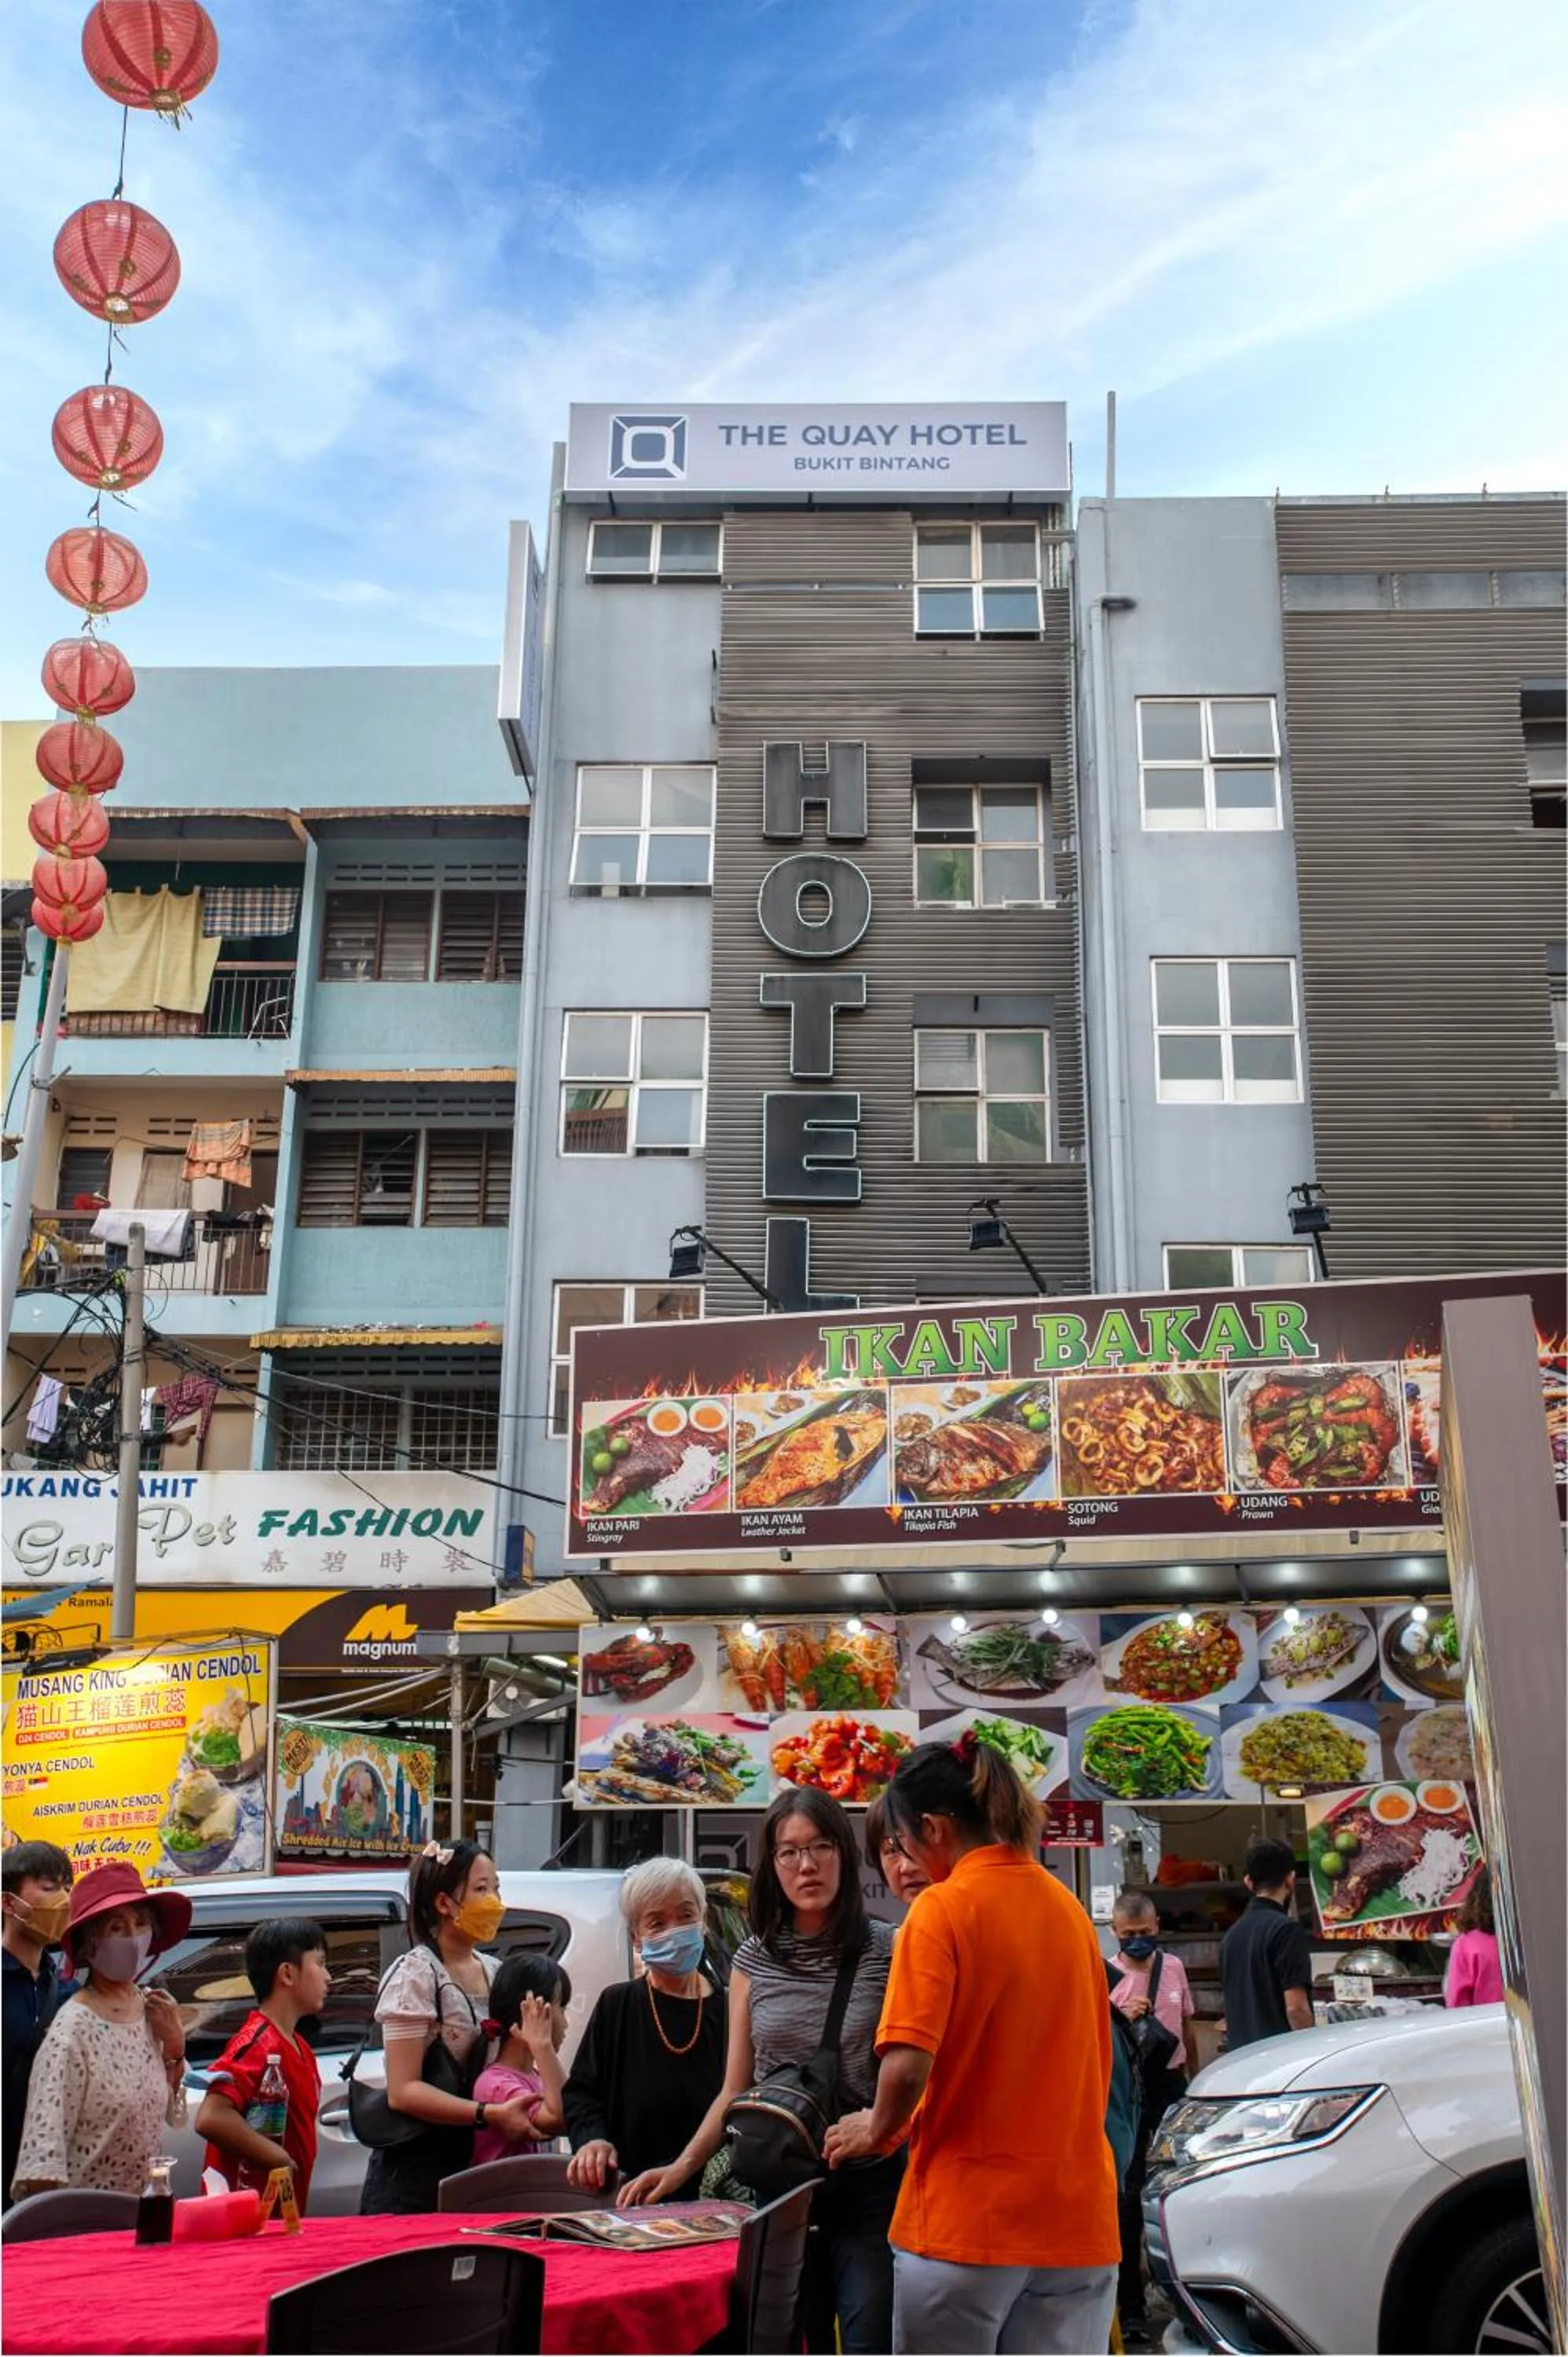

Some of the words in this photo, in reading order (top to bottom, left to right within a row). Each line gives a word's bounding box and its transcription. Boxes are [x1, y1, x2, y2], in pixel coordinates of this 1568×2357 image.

[718, 424, 787, 445] THE
[801, 423, 898, 446] QUAY
[909, 423, 1027, 445] HOTEL
[793, 456, 854, 471] BUKIT
[859, 456, 951, 471] BINTANG
[758, 740, 870, 1314] HOTEL
[820, 1316, 1017, 1380] IKAN
[1035, 1302, 1319, 1371] BAKAR
[1068, 1502, 1119, 1514] SOTONG
[1241, 1496, 1288, 1508] UDANG
[741, 1515, 770, 1527] IKAN
[771, 1513, 804, 1524] AYAM
[904, 1509, 933, 1520] IKAN
[935, 1508, 979, 1519] TILAPIA
[1068, 1515, 1096, 1526] Squid
[1241, 1509, 1273, 1519] Prawn
[257, 1508, 485, 1537] FASHION
[587, 1521, 614, 1532] IKAN
[615, 1519, 639, 1530] PARI
[904, 1521, 936, 1532] Tilapia
[937, 1520, 956, 1530] Fish
[741, 1527, 776, 1538] Leather
[777, 1525, 806, 1536] Jacket
[586, 1533, 623, 1544] Stingray
[342, 1642, 417, 1659] magnum
[16, 1674, 84, 1699] MUSANG
[89, 1670, 126, 1692] KING
[132, 1660, 192, 1687] RIAN
[197, 1655, 262, 1679] CENDOL
[34, 1732, 68, 1742] CENDOL
[46, 1757, 94, 1772] CENDOL
[33, 1802, 76, 1816] AISKRIM
[78, 1798, 119, 1813] DURIAN
[121, 1794, 163, 1808] CENDOL
[283, 1833, 329, 1846] Shredded
[73, 1839, 97, 1857] Nak
[100, 1836, 133, 1853] Cuba
